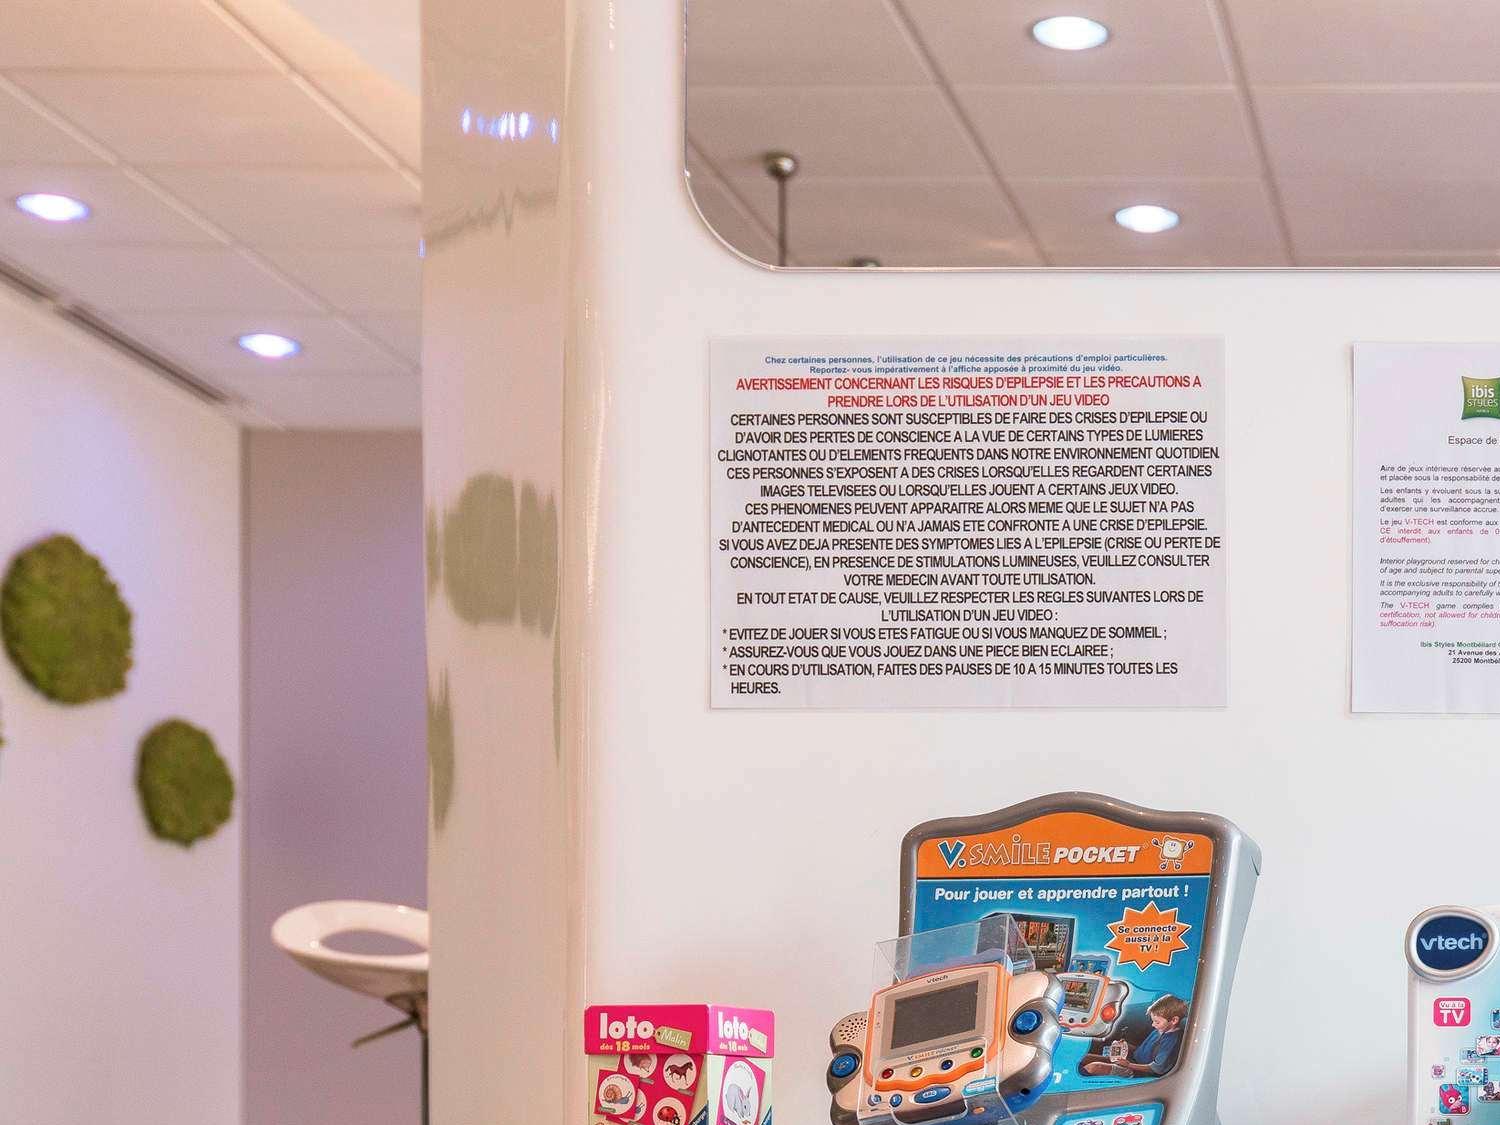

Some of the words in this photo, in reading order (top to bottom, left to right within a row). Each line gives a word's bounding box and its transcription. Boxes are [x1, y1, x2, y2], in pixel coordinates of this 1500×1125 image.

[736, 378, 832, 390] AVERTISSEMENT
[834, 378, 915, 389] CONCERNANT
[918, 377, 940, 389] LES
[943, 377, 993, 389] RISQUES
[996, 377, 1064, 388] D'EPILEPSIE
[1067, 376, 1081, 388] ET
[1084, 376, 1105, 388] LES
[1108, 376, 1190, 387] PRECAUTIONS
[1193, 376, 1201, 387] A
[1472, 385, 1494, 398] ibis
[828, 396, 884, 407] PRENDRE
[886, 396, 917, 407] LORS
[920, 395, 936, 407] DE
[939, 395, 1017, 406] L'UTILISATION
[1020, 395, 1047, 406] D'UN
[1049, 394, 1072, 406] JEU
[1074, 394, 1109, 406] VIDEO
[731, 414, 796, 425] CERTAINES
[798, 414, 869, 425] PERSONNES
[872, 413, 903, 425] SONT
[906, 413, 992, 424] SUSCEPTIBLES
[995, 413, 1010, 424] DE
[1013, 412, 1046, 424] FAIRE
[1049, 412, 1072, 423] DES
[1075, 412, 1117, 423] CRISES
[1120, 412, 1187, 423] D'EPILEPSIE
[1190, 411, 1207, 423] OU
[1448, 436, 1483, 446] Espace
[1485, 436, 1497, 445] de
[844, 574, 883, 586] VOTRE
[886, 574, 938, 585] MEDECIN
[940, 574, 980, 585] AVANT
[982, 573, 1021, 585] TOUTE
[1023, 573, 1095, 585] UTILISATION.
[882, 610, 960, 621] L'UTILISATION
[963, 610, 990, 621] D'UN
[993, 609, 1015, 621] JEU
[1017, 609, 1053, 621] VIDEO
[730, 664, 745, 676] EN
[746, 664, 789, 676] COURS
[792, 664, 874, 675] D'UTILISATION,
[877, 664, 917, 675] FAITES
[919, 664, 943, 675] DES
[945, 663, 992, 675] PAUSES
[995, 663, 1011, 675] DE
[1013, 663, 1025, 674] 10
[1028, 663, 1037, 674] A
[1039, 663, 1051, 674] 15
[1054, 663, 1104, 674] MINUTES
[1107, 663, 1153, 674] TOUTES
[1156, 663, 1178, 674] LES
[731, 682, 781, 694] HEURES.
[1054, 845, 1141, 864] POCKET
[934, 888, 970, 901] Pour
[974, 887, 1013, 902] jouer
[1018, 888, 1033, 899] et
[1037, 886, 1117, 902] apprendre
[1122, 885, 1180, 901] partout
[1118, 925, 1130, 934] Se
[1132, 924, 1177, 933] connecte
[1125, 934, 1150, 943] aussi
[1152, 934, 1159, 943] à
[1161, 934, 1171, 942] la
[1420, 933, 1483, 951] vtech
[1138, 944, 1152, 952] TV
[1440, 1010, 1464, 1024] TV
[600, 1013, 654, 1039] loto
[718, 1011, 748, 1040] loto
[616, 1041, 630, 1051] 18
